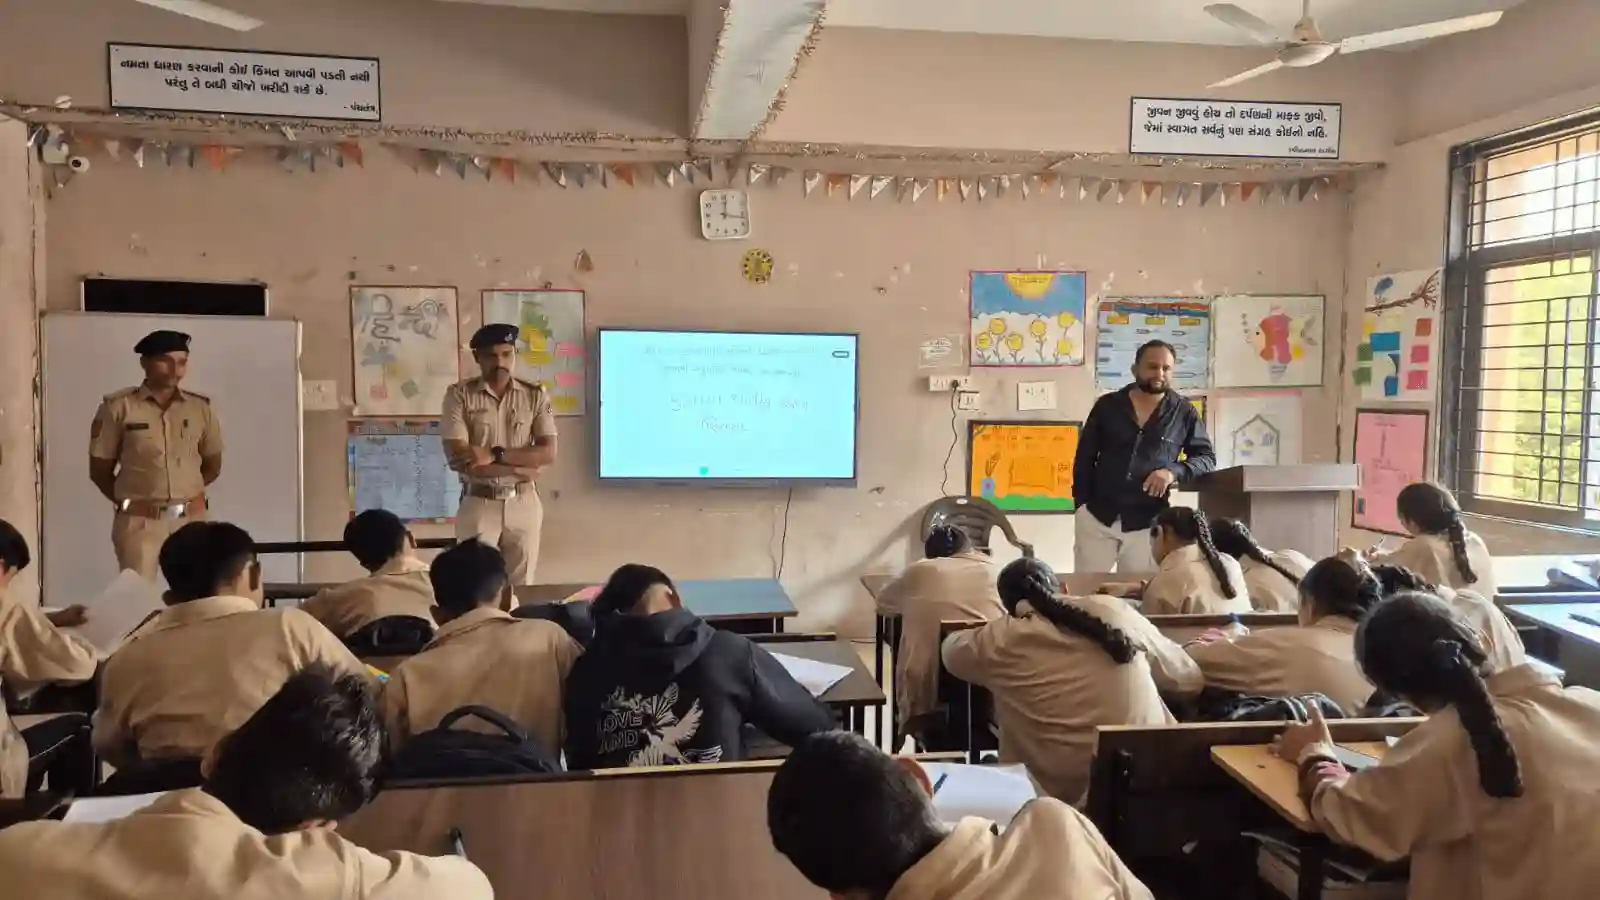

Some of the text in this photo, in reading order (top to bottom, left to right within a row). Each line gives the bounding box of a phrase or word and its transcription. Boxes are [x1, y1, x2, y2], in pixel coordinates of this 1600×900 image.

[187, 60, 224, 74] કરવાની
[321, 68, 346, 81] પડતી
[350, 69, 370, 82] નથી
[165, 76, 188, 91] પરંતુ
[191, 77, 200, 88] તે
[205, 78, 227, 90] બધી
[231, 79, 256, 91] ચીજો
[1147, 105, 1172, 119] જીવન
[1203, 105, 1221, 119] હોય
[1224, 105, 1236, 119] તો
[1167, 123, 1197, 134] સ્વાગત
[1228, 125, 1244, 136] પણ
